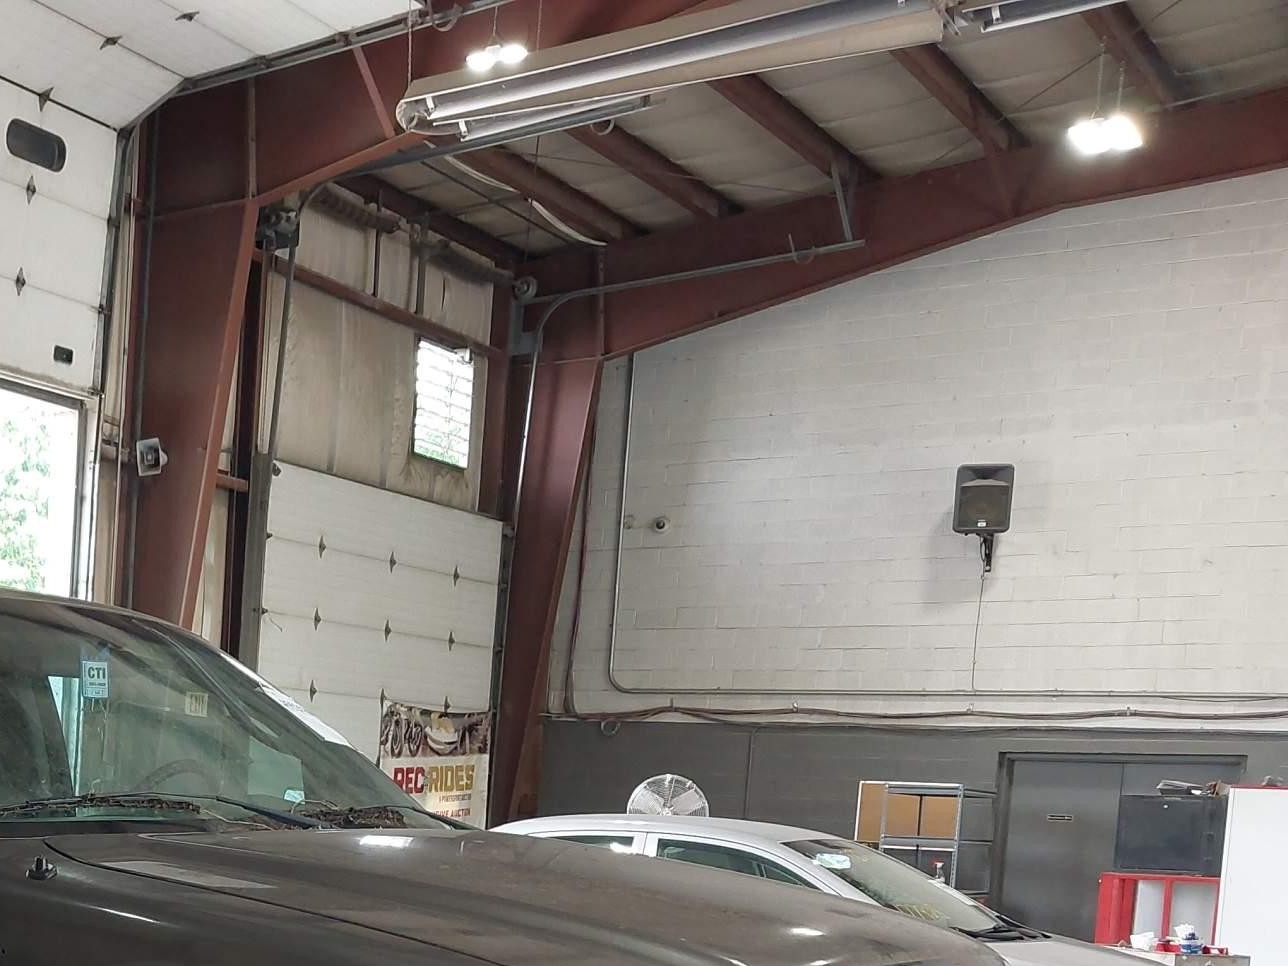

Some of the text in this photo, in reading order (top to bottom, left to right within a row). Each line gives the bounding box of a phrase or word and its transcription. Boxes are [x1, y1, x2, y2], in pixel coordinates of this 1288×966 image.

[88, 667, 106, 679] CTI
[393, 764, 475, 794] REC RIDES
